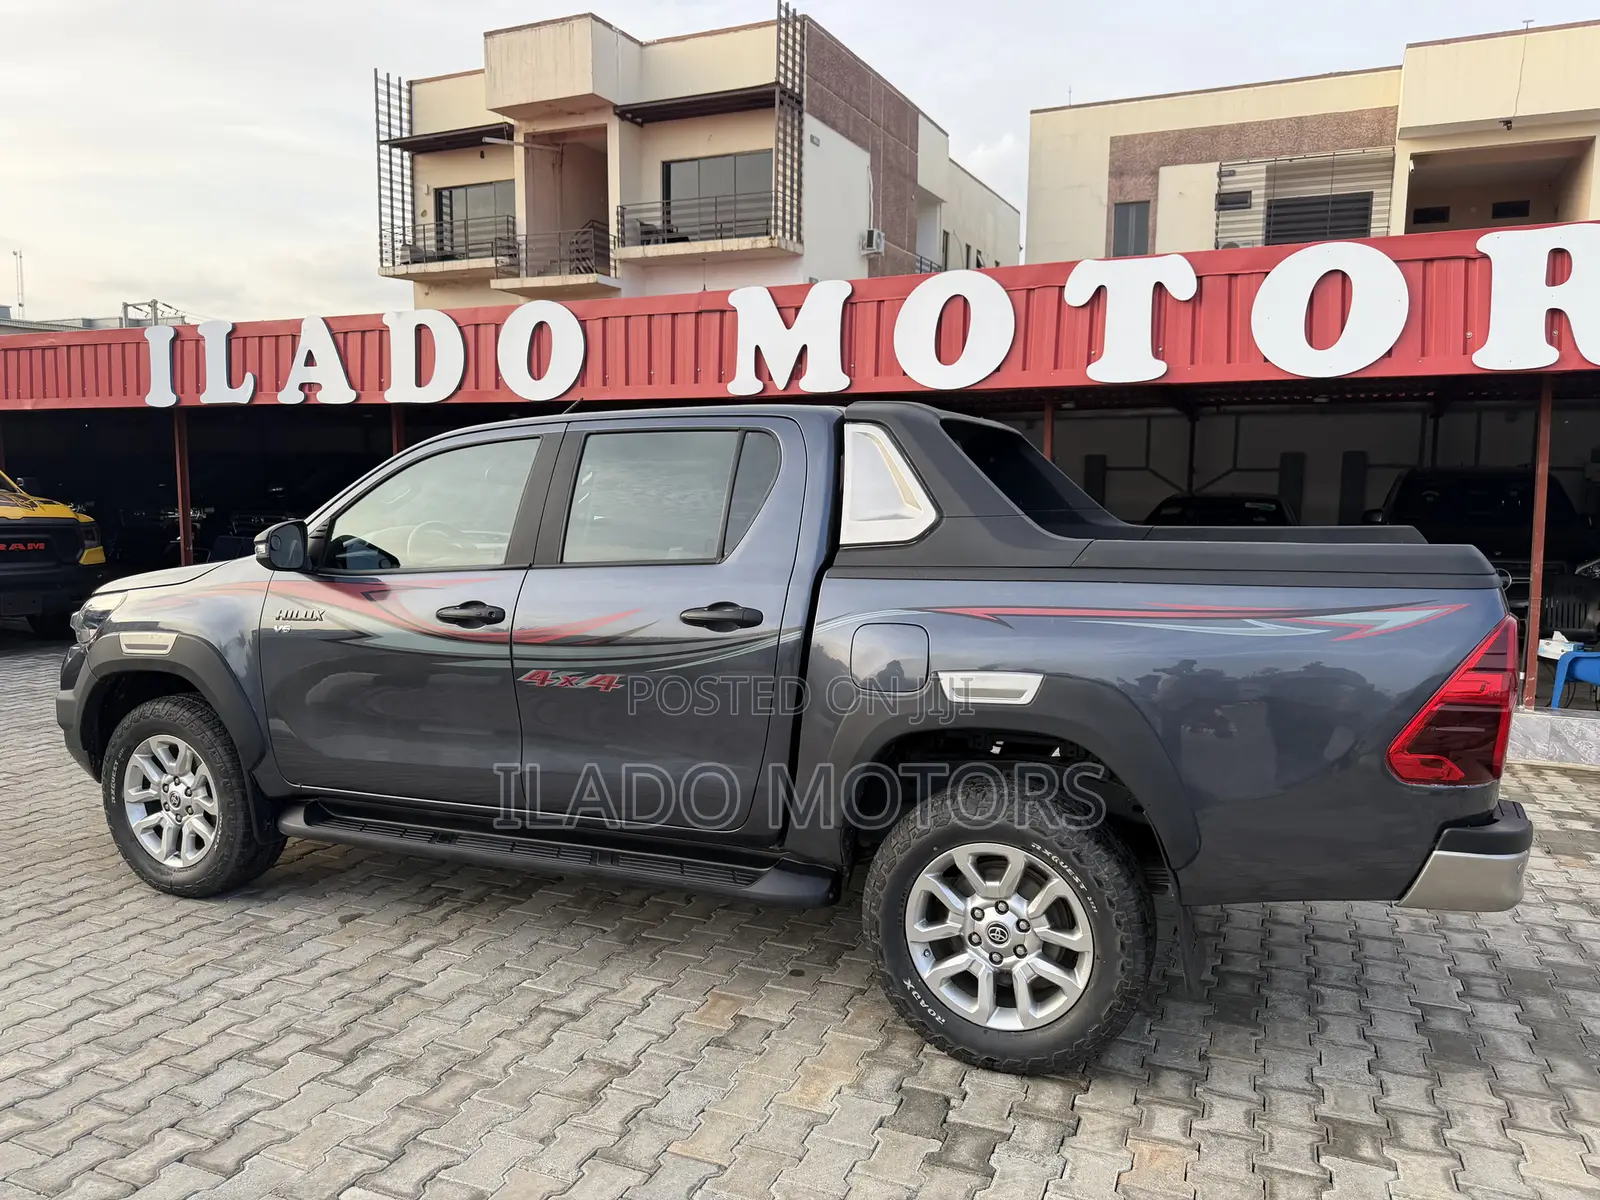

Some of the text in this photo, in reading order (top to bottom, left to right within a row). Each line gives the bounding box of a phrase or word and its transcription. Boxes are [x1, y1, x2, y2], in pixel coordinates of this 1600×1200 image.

[144, 223, 1600, 408] ILADO MOTOR
[275, 609, 326, 621] HILUX
[273, 624, 292, 633] V6
[517, 669, 626, 692] 4x4
[903, 978, 947, 1026] ROADX
